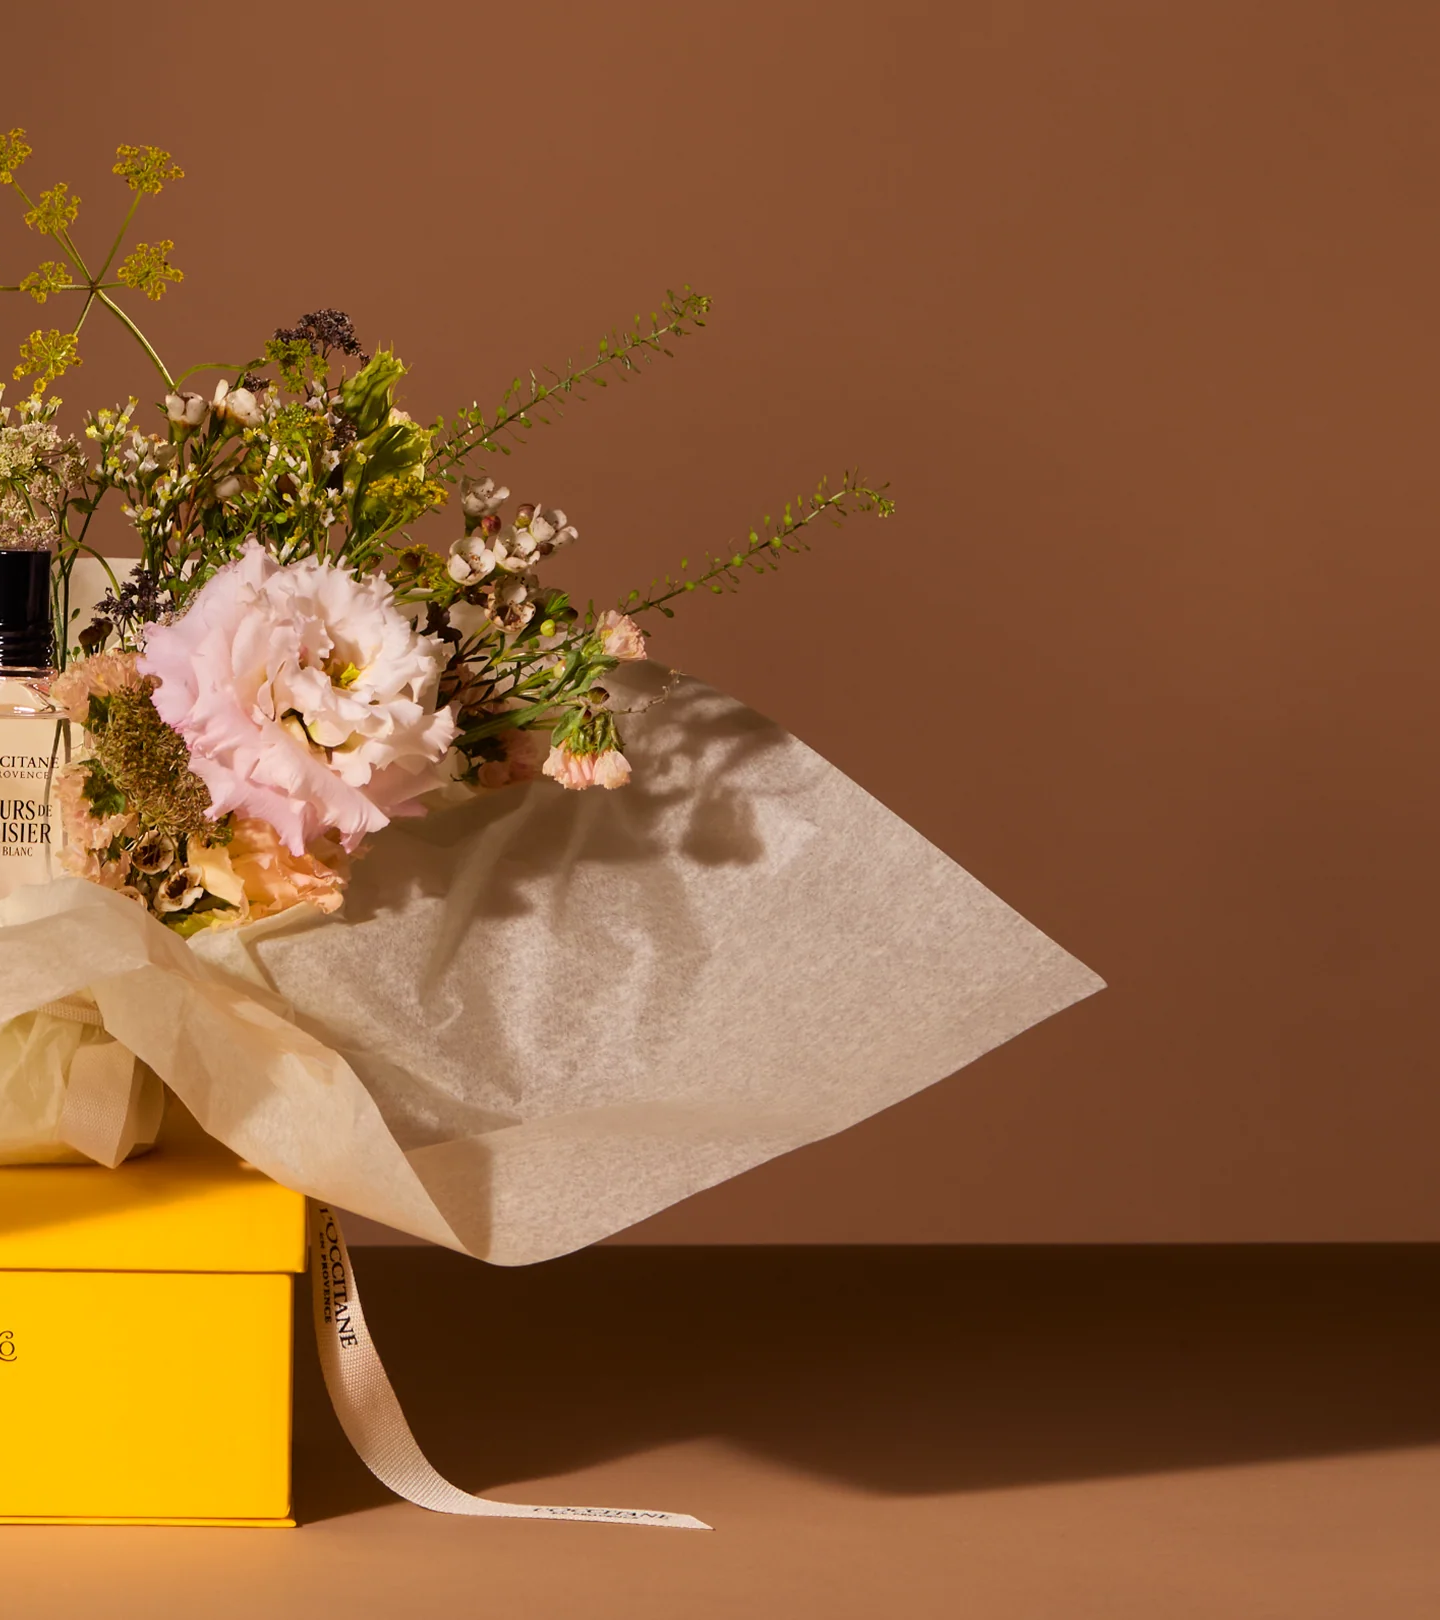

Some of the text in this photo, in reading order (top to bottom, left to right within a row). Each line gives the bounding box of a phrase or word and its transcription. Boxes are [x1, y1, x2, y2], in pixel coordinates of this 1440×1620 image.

[38, 804, 53, 817] DE
[2, 846, 33, 857] BLANC
[321, 1254, 332, 1324] PROVENCE
